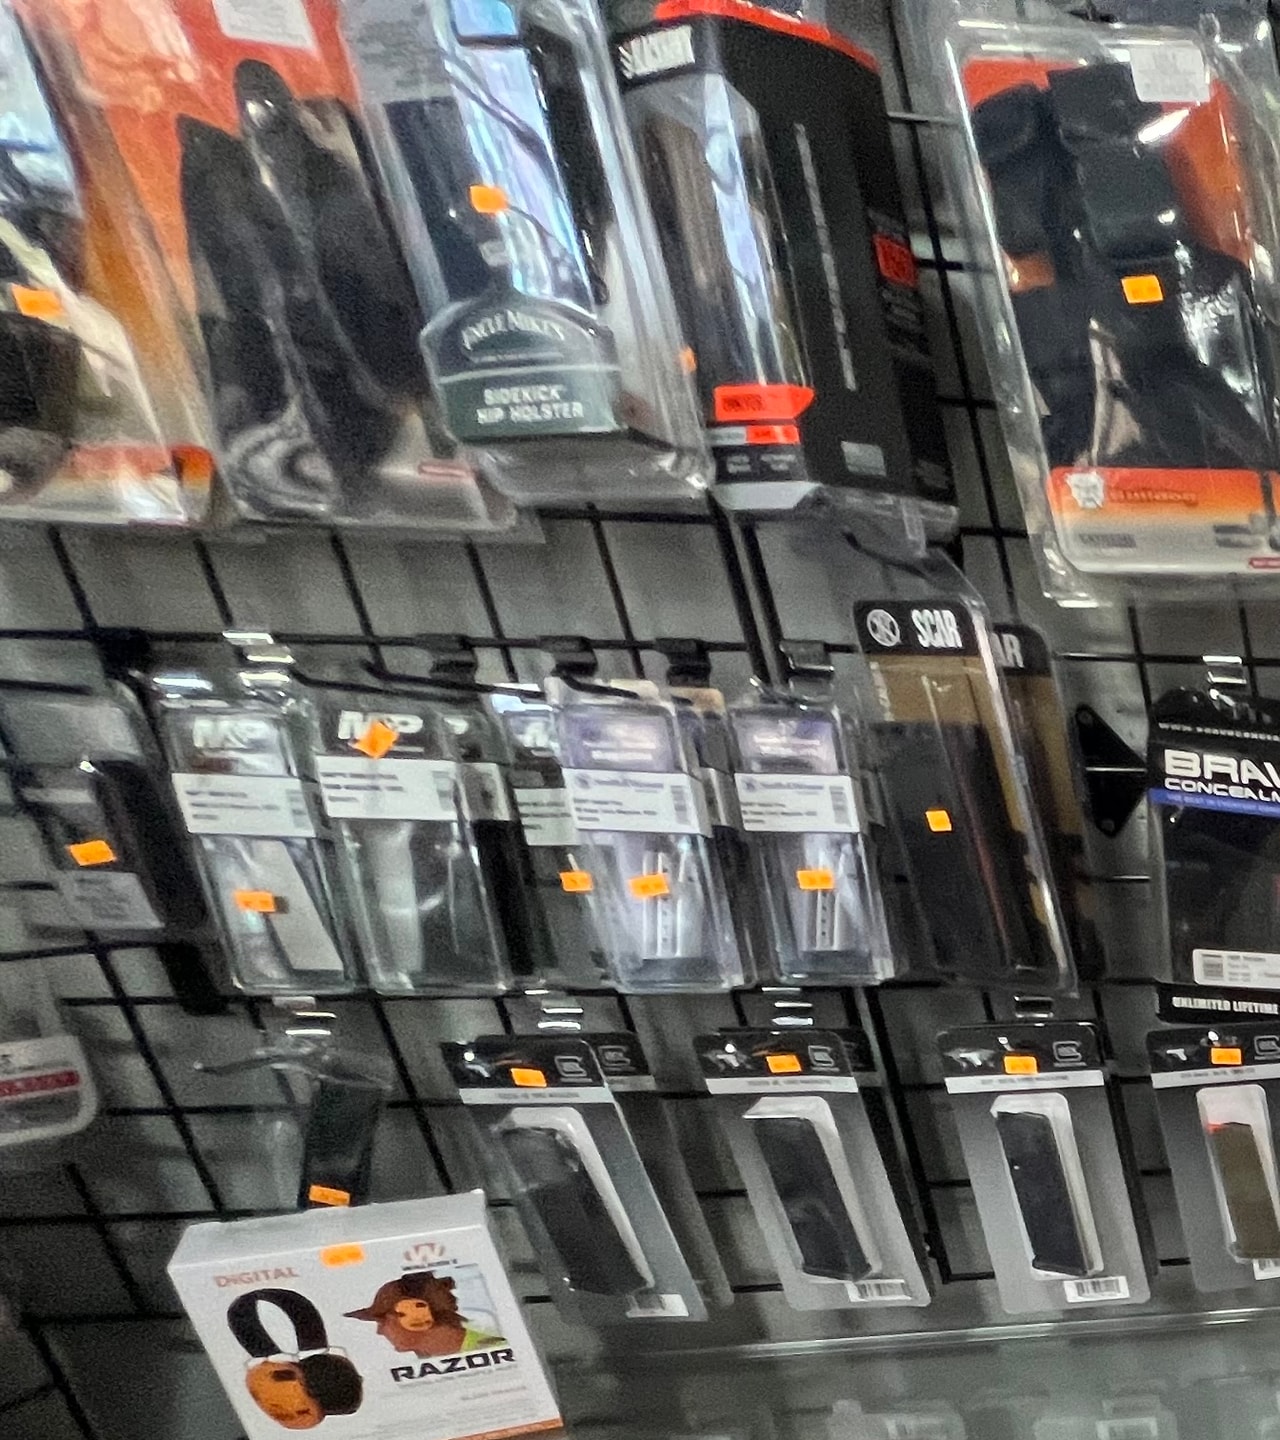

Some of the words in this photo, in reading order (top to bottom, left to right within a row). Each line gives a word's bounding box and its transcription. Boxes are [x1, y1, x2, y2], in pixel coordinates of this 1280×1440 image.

[911, 609, 964, 648] SCAR
[214, 1267, 300, 1288] DIGITAL
[391, 1349, 516, 1383] RAZOR
